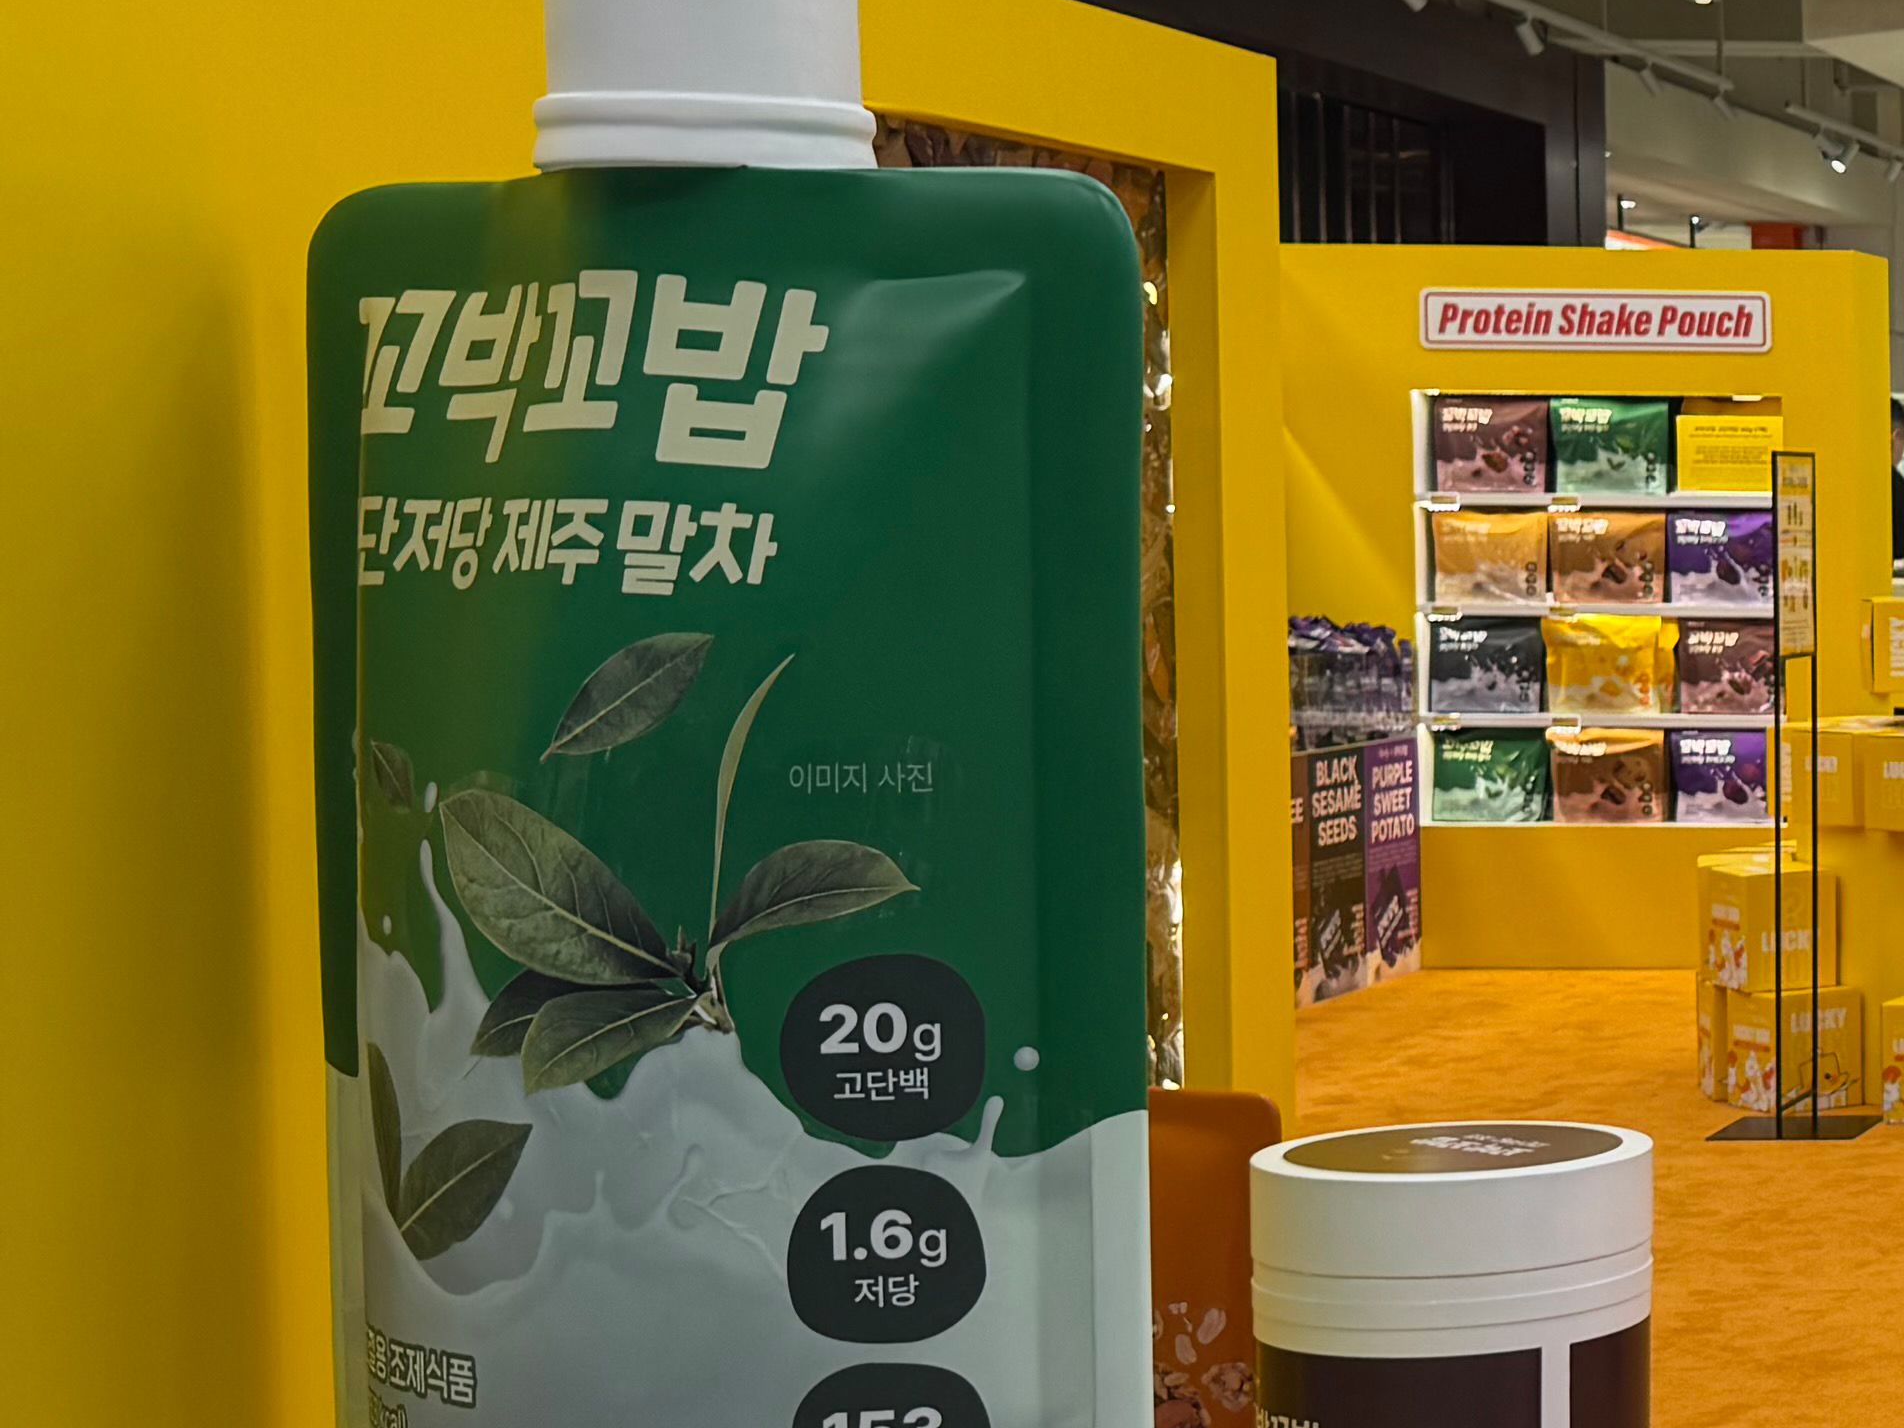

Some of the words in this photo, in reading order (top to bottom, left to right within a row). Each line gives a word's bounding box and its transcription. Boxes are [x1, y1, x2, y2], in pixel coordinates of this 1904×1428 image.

[1438, 302, 1553, 336] Protein
[1558, 303, 1653, 337] Shake
[1657, 304, 1754, 339] Pouch
[358, 269, 830, 469] 꼬박꼬밥
[357, 495, 493, 591] 단저당
[492, 498, 609, 586] 제주
[616, 500, 778, 597] 말차
[788, 762, 868, 794] 이미지
[876, 761, 935, 794] 사진
[1315, 754, 1359, 788] BLACK
[1371, 759, 1413, 791] PURPLE
[1311, 783, 1362, 819] SESAME
[1372, 786, 1413, 817] SWEET
[1317, 814, 1358, 848] SEEDS
[1370, 813, 1416, 845] POTATO
[818, 1001, 944, 1064] 20g
[833, 1067, 931, 1103] 고단백
[818, 1208, 949, 1268] 1.6g
[853, 1274, 921, 1309] 저당
[389, 1342, 476, 1406] 조제식품
